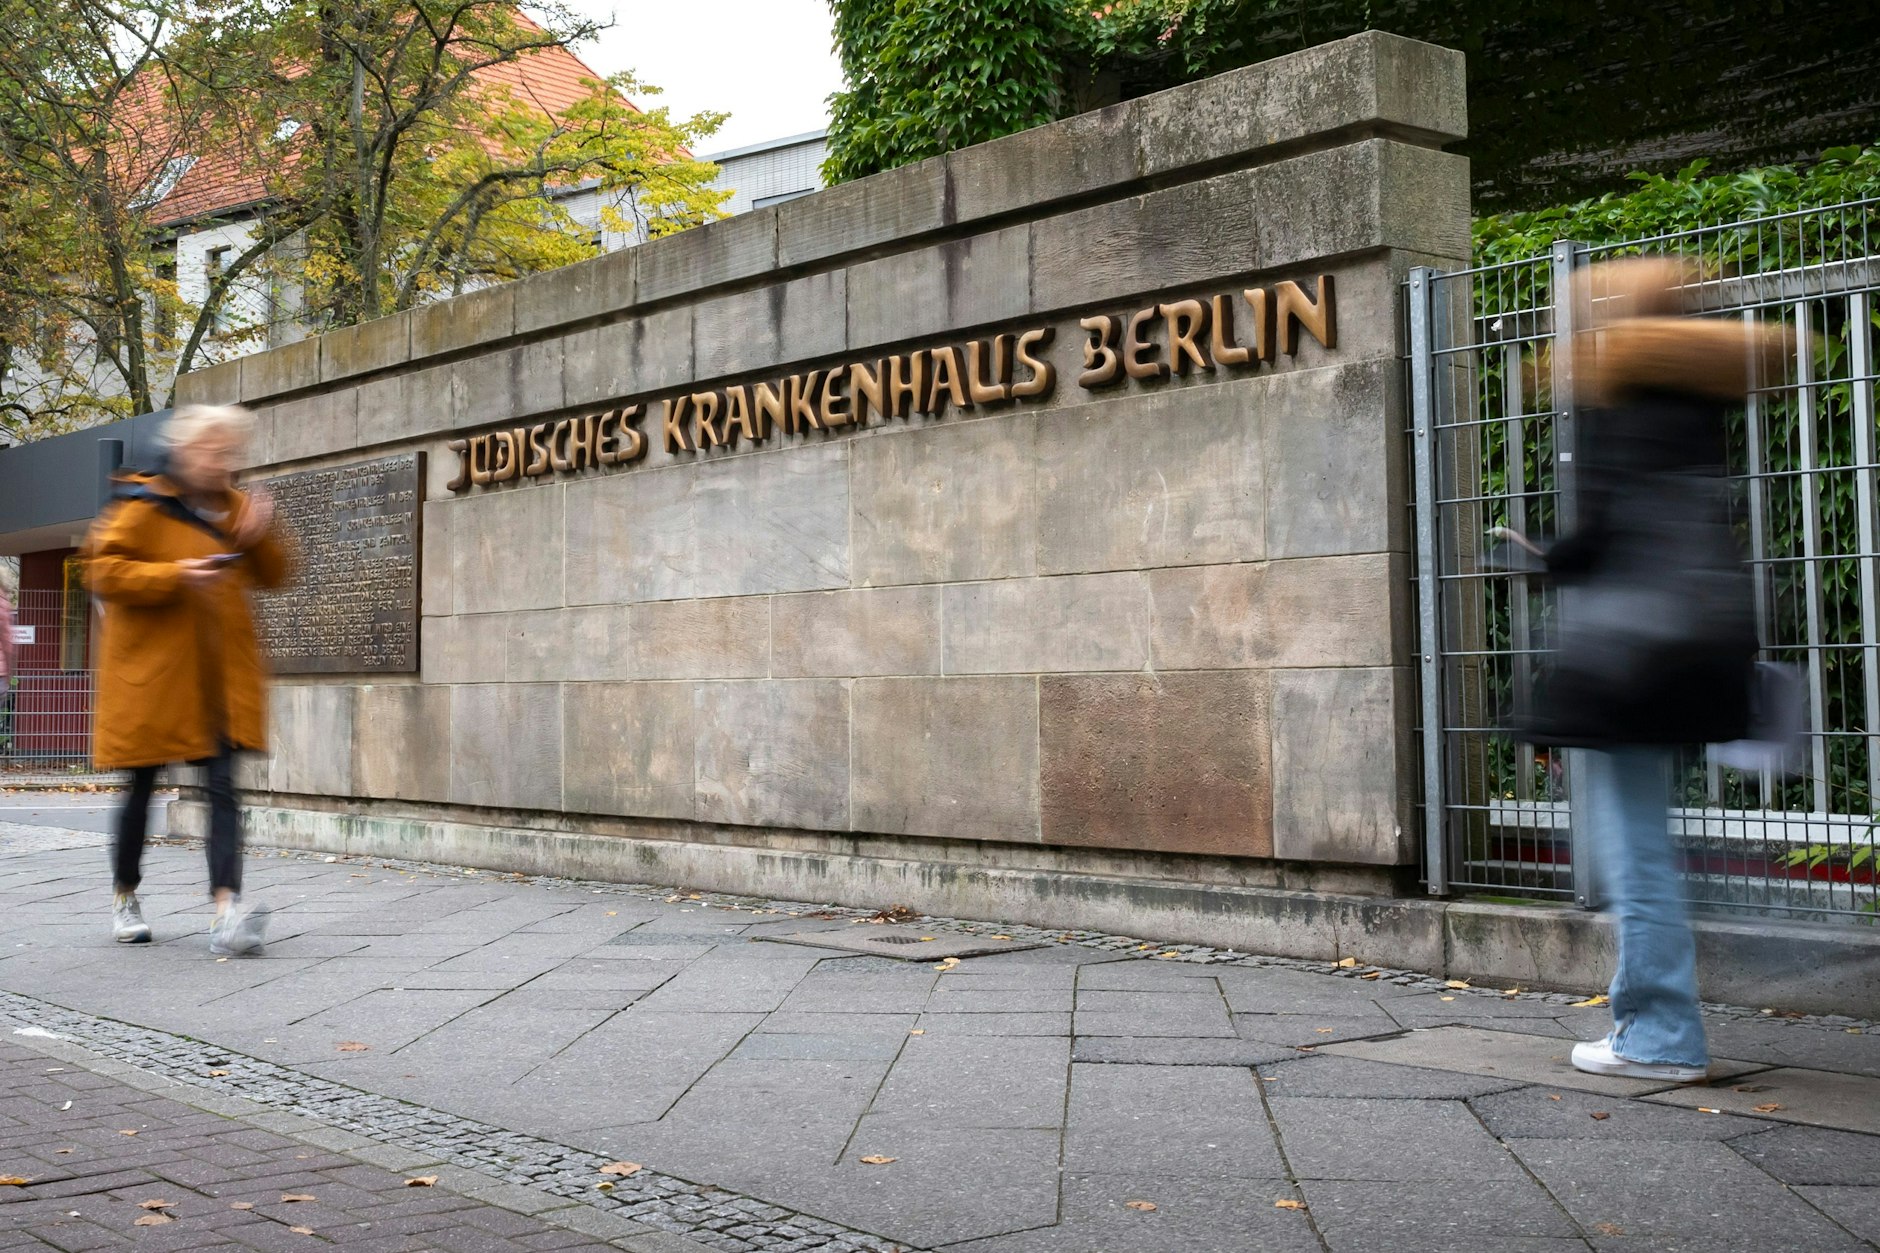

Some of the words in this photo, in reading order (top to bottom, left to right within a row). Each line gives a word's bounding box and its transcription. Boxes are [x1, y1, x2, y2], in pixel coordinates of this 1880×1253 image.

[447, 403, 648, 492] JÜDISCHES
[662, 327, 1057, 455] KRANKENHAUS
[1078, 274, 1338, 391] BERLIN
